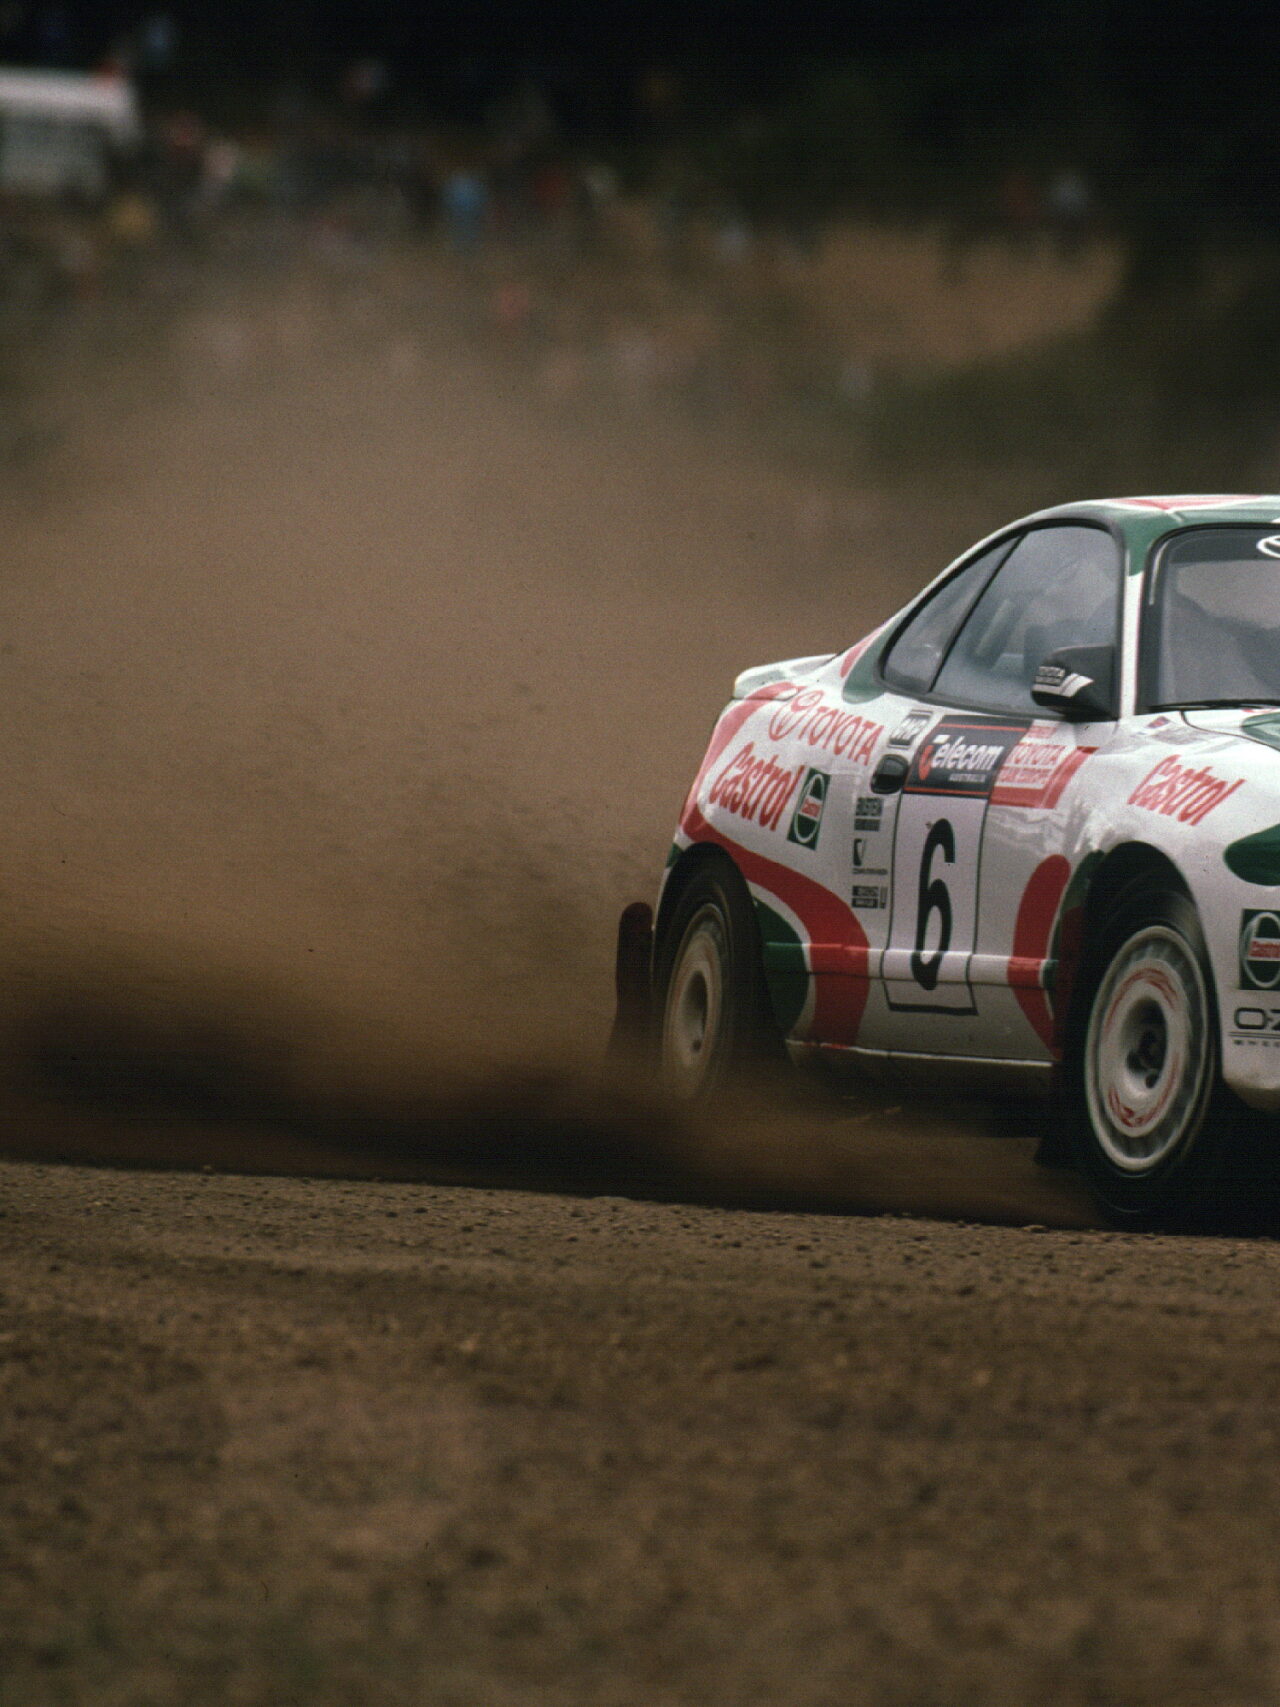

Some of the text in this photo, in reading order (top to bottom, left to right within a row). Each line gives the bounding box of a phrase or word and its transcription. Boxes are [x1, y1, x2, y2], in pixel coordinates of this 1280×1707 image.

[797, 704, 885, 767] TOYOTA
[708, 741, 806, 832] Castrol
[1127, 754, 1247, 827] Castrol
[910, 818, 956, 991] 6
